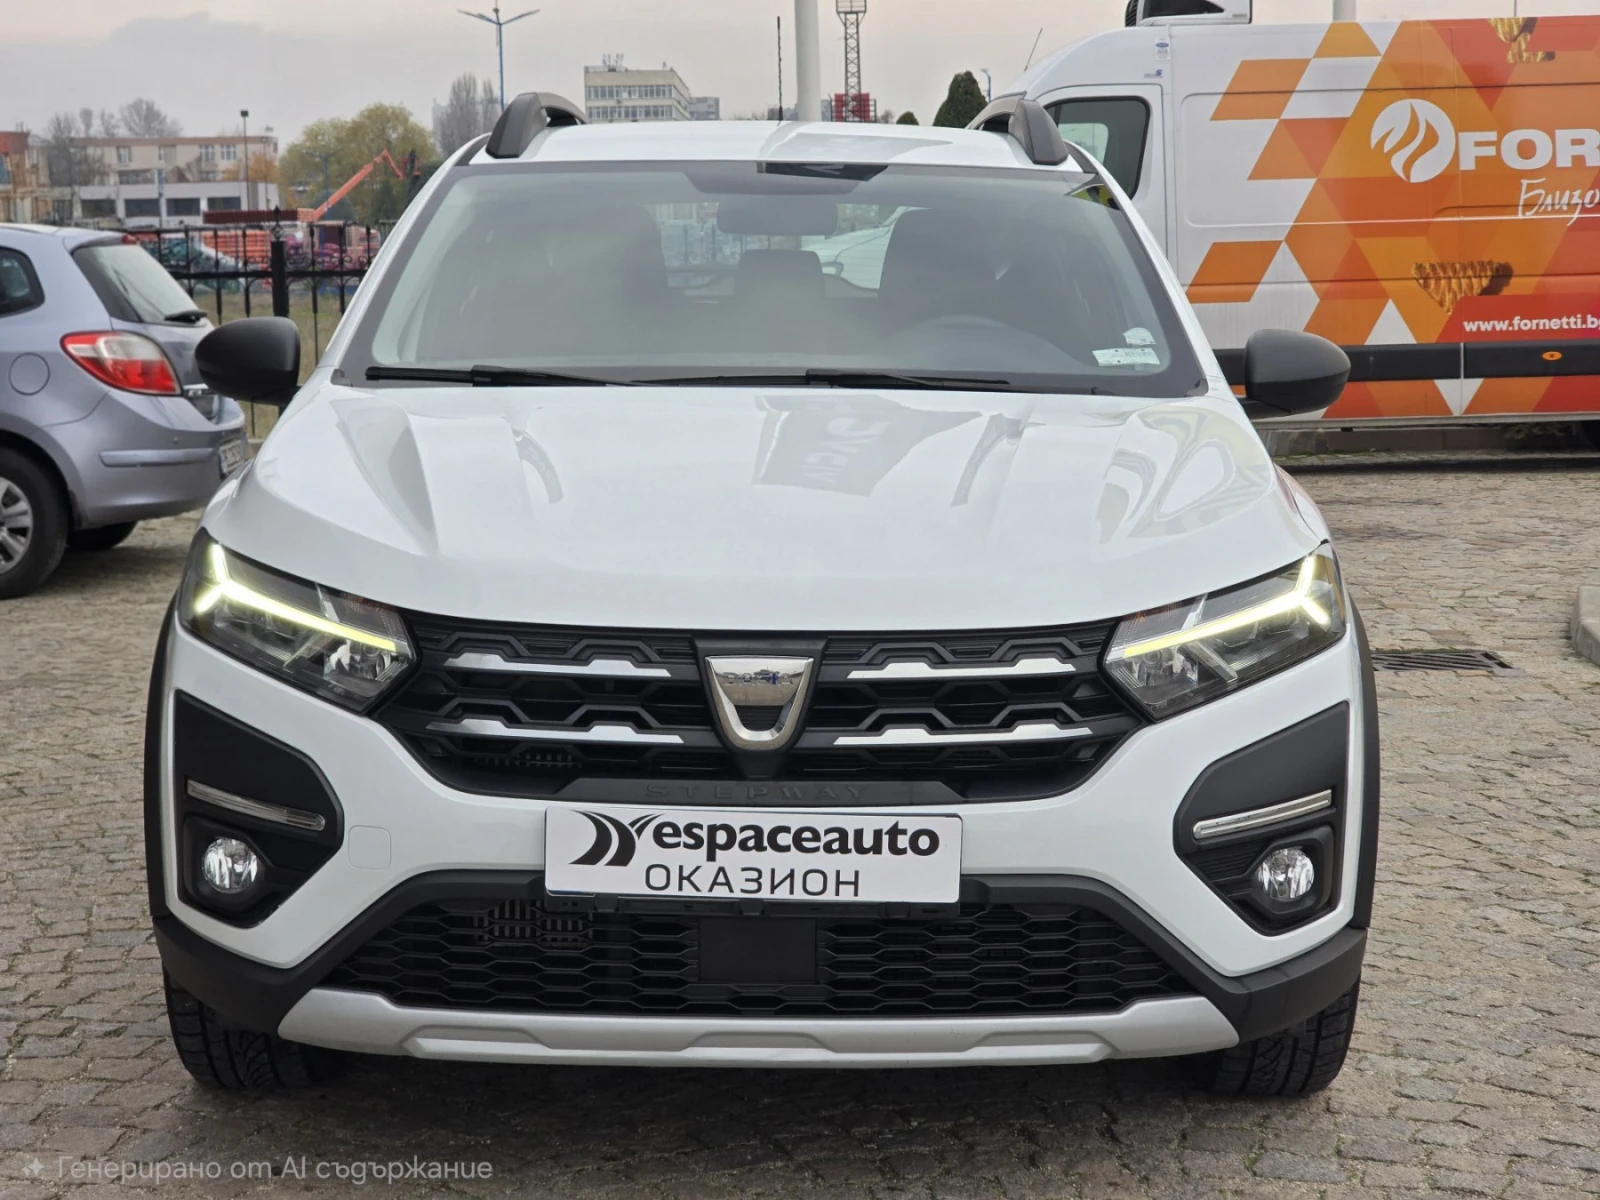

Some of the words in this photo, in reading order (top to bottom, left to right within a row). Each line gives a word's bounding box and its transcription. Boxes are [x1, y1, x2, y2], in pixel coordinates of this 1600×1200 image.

[1458, 129, 1600, 170] FOR
[1518, 178, 1600, 226] Близо
[1463, 314, 1600, 332] www.fornetti.b
[646, 785, 868, 799] STEPWAY
[652, 820, 940, 862] espaceauto
[645, 863, 860, 897] ОКАЗИОН
